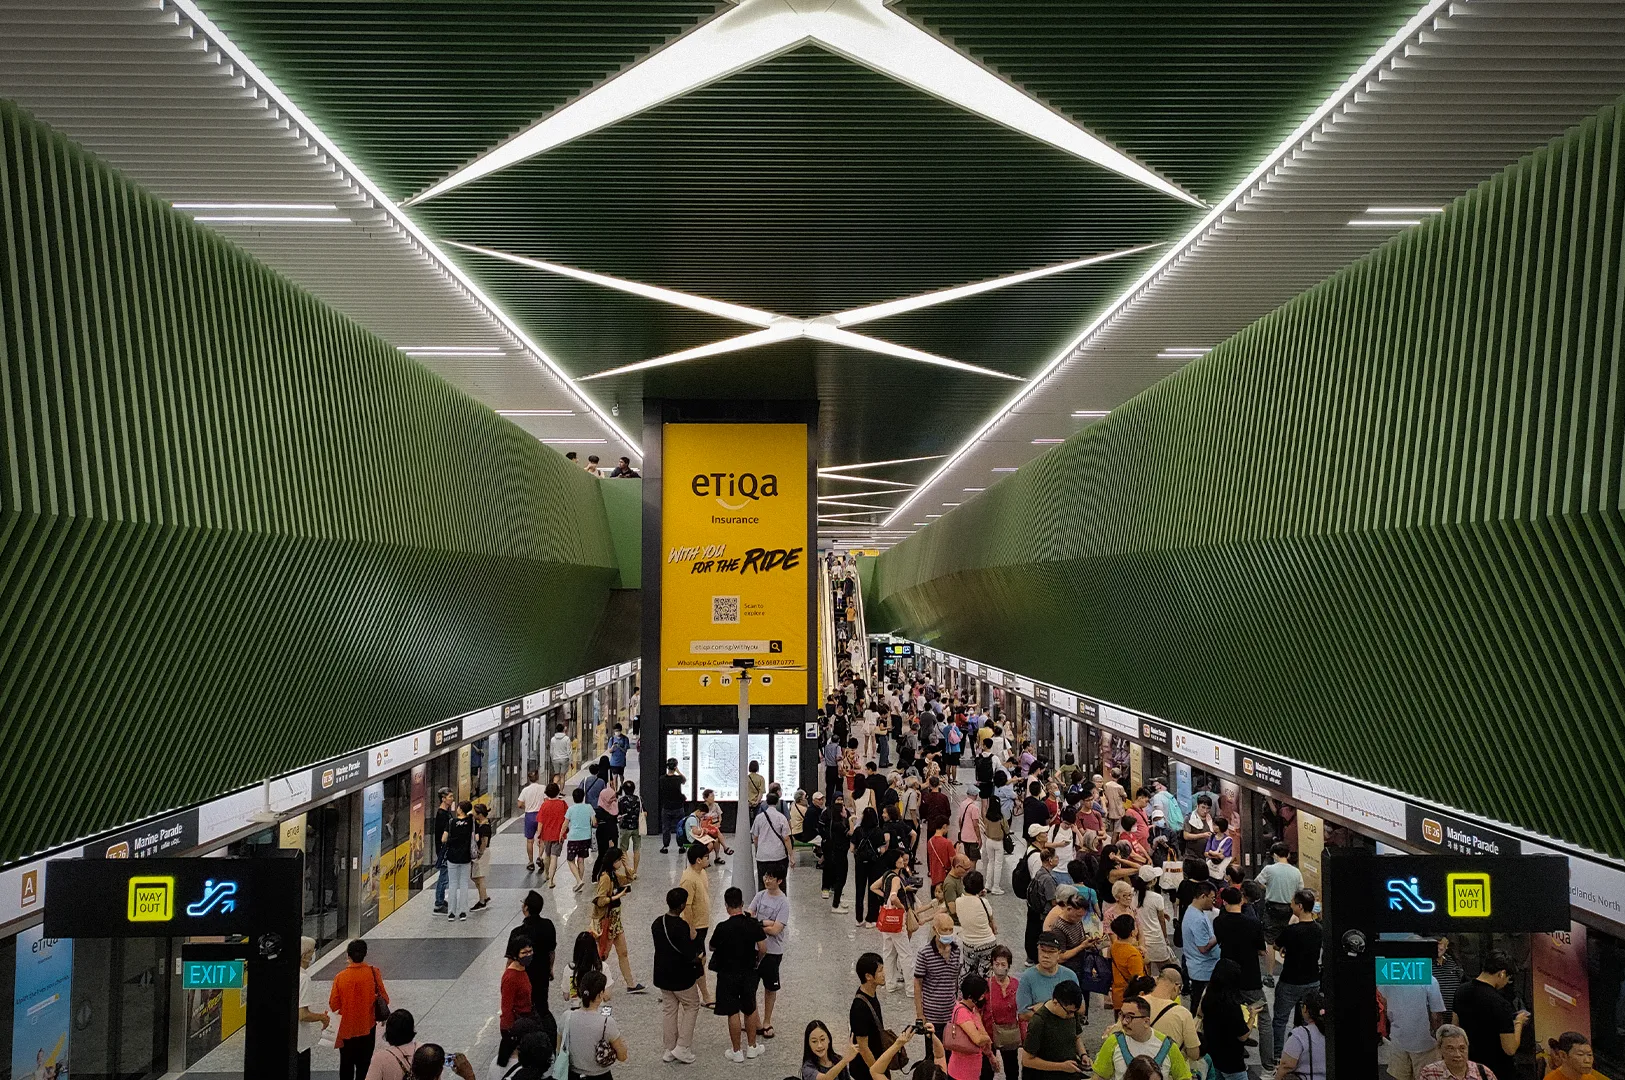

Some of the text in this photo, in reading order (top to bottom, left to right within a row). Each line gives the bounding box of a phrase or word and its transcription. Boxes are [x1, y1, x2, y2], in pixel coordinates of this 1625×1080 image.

[691, 472, 779, 501] eTiQa
[711, 515, 760, 524] Insurance
[668, 543, 727, 564] WITH YOU
[690, 547, 804, 575] FOR THE RIDE
[134, 833, 159, 851] Marine
[159, 823, 183, 841] Parade
[1424, 824, 1440, 838] TE 26
[1446, 826, 1500, 855] Marine Parade
[24, 877, 34, 896] A
[1457, 888, 1480, 898] WAY
[139, 892, 162, 902] WAY
[1459, 899, 1479, 909] OUT
[1568, 886, 1621, 912] dlands North
[139, 903, 161, 913] OUT
[189, 965, 227, 984] EXIT
[1390, 961, 1426, 980] EXIT
